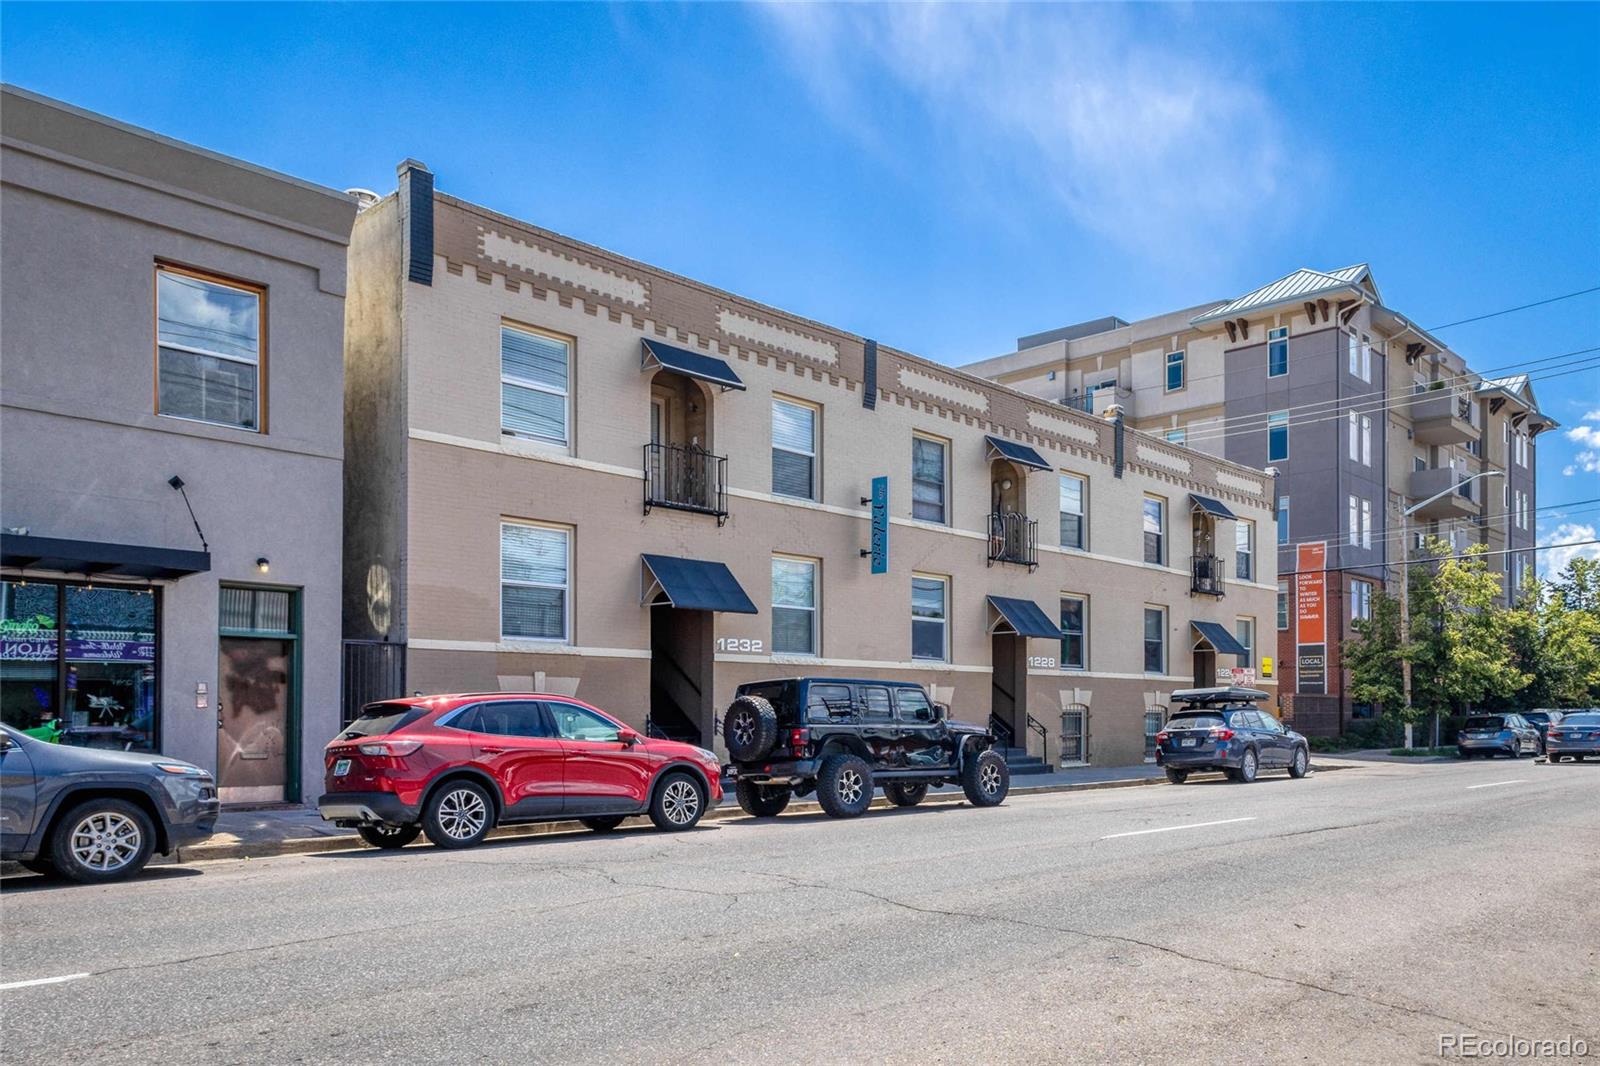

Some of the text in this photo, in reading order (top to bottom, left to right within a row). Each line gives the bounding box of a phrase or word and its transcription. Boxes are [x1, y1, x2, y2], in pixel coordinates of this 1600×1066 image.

[717, 638, 763, 652] 1232
[1028, 656, 1056, 667] 1228
[1217, 668, 1231, 677] 122
